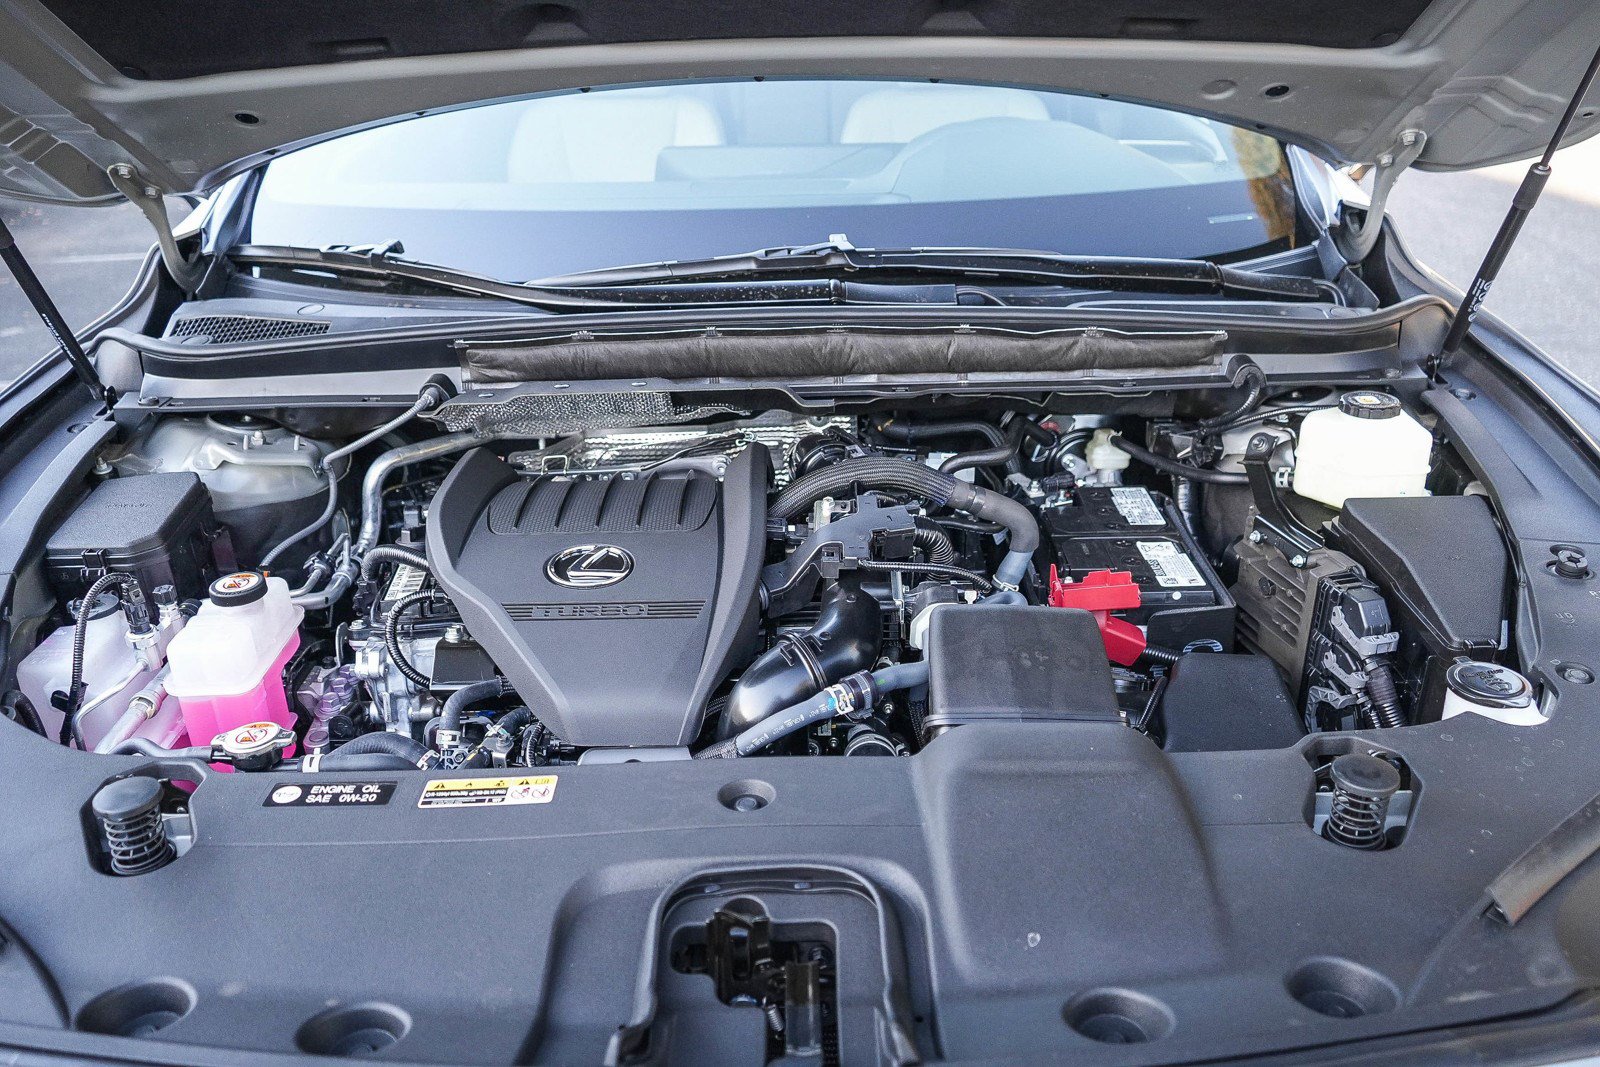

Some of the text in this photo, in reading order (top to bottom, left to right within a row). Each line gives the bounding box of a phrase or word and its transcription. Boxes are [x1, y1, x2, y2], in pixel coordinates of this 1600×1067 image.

[534, 603, 646, 617] TURBO
[310, 784, 381, 794] ENGINE OIL
[305, 794, 332, 803] SAE
